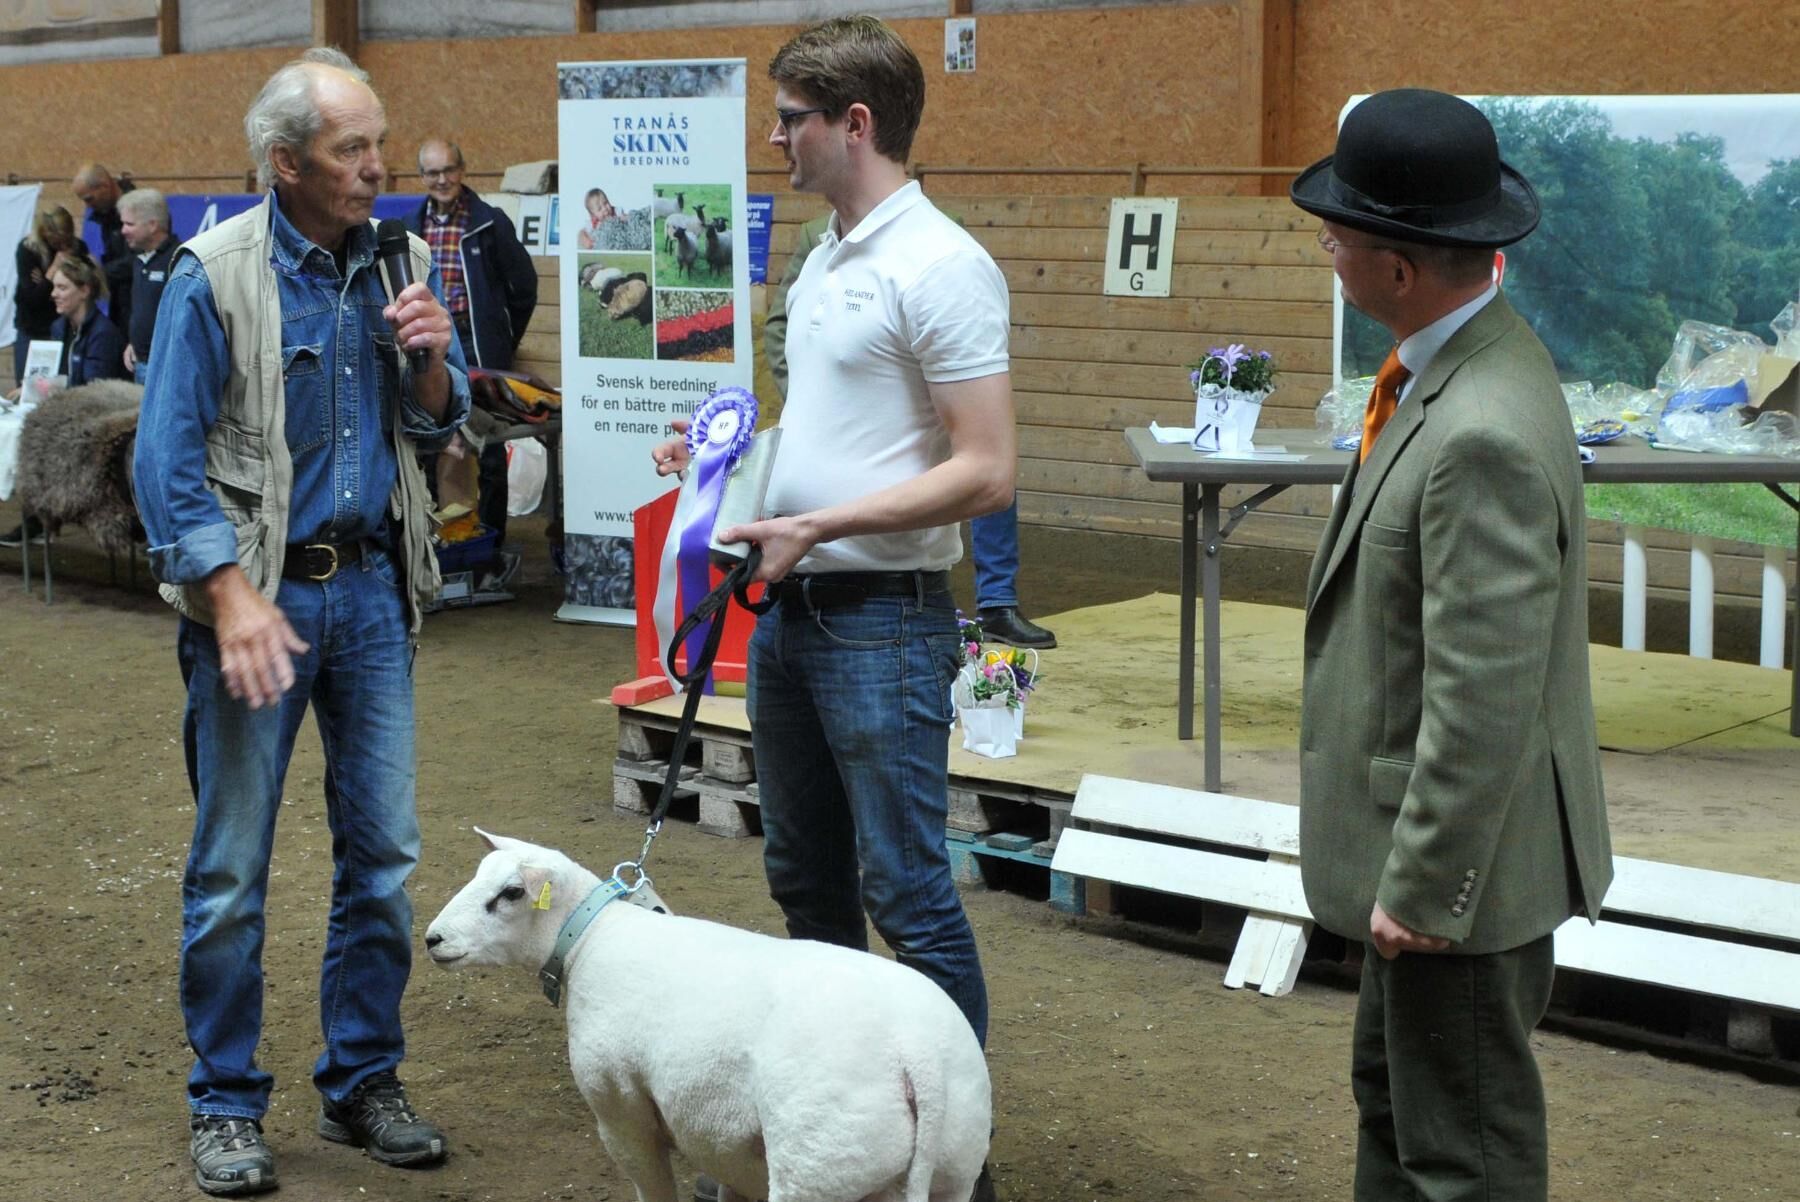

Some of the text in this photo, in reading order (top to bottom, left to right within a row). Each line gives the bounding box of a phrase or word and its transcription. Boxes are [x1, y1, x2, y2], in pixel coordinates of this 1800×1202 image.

[613, 112, 689, 130] TRANÅS
[613, 133, 688, 152] SKINN
[613, 156, 690, 166] BEREDNING
[522, 216, 541, 245] E
[1119, 213, 1162, 270] H
[1130, 272, 1144, 291] G
[596, 374, 717, 395] Svensk beredning
[581, 395, 598, 409] för
[603, 399, 619, 411] en
[625, 397, 666, 413] bättre
[594, 421, 610, 432] en
[616, 421, 658, 434] renare
